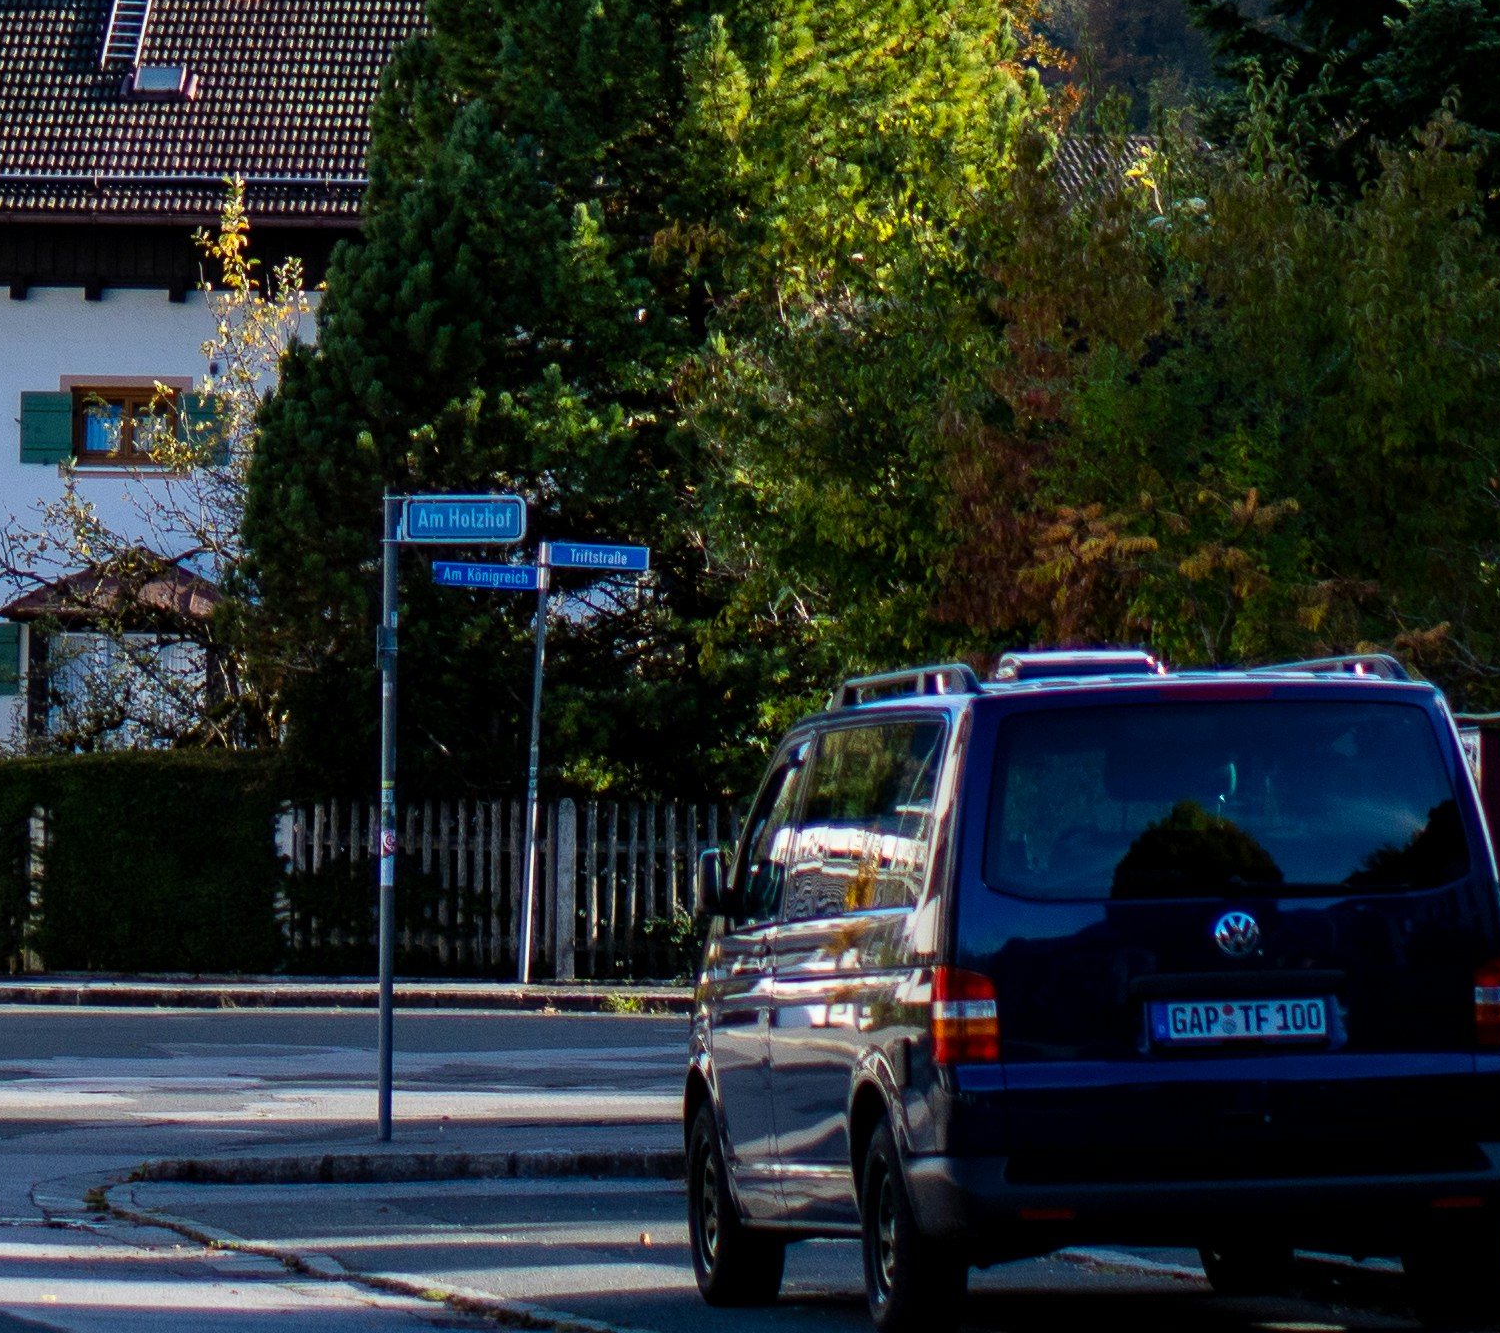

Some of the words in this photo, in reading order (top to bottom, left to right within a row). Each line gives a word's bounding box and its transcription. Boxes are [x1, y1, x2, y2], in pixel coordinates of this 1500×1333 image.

[418, 507, 444, 528] Am
[449, 507, 512, 528] Holzhof
[571, 548, 628, 566] Triftstraße
[443, 566, 462, 581] Am
[467, 567, 528, 587] Königreich
[1171, 1006, 1219, 1034] GAP
[1237, 1004, 1270, 1033] TF
[1275, 1002, 1322, 1032] 100
